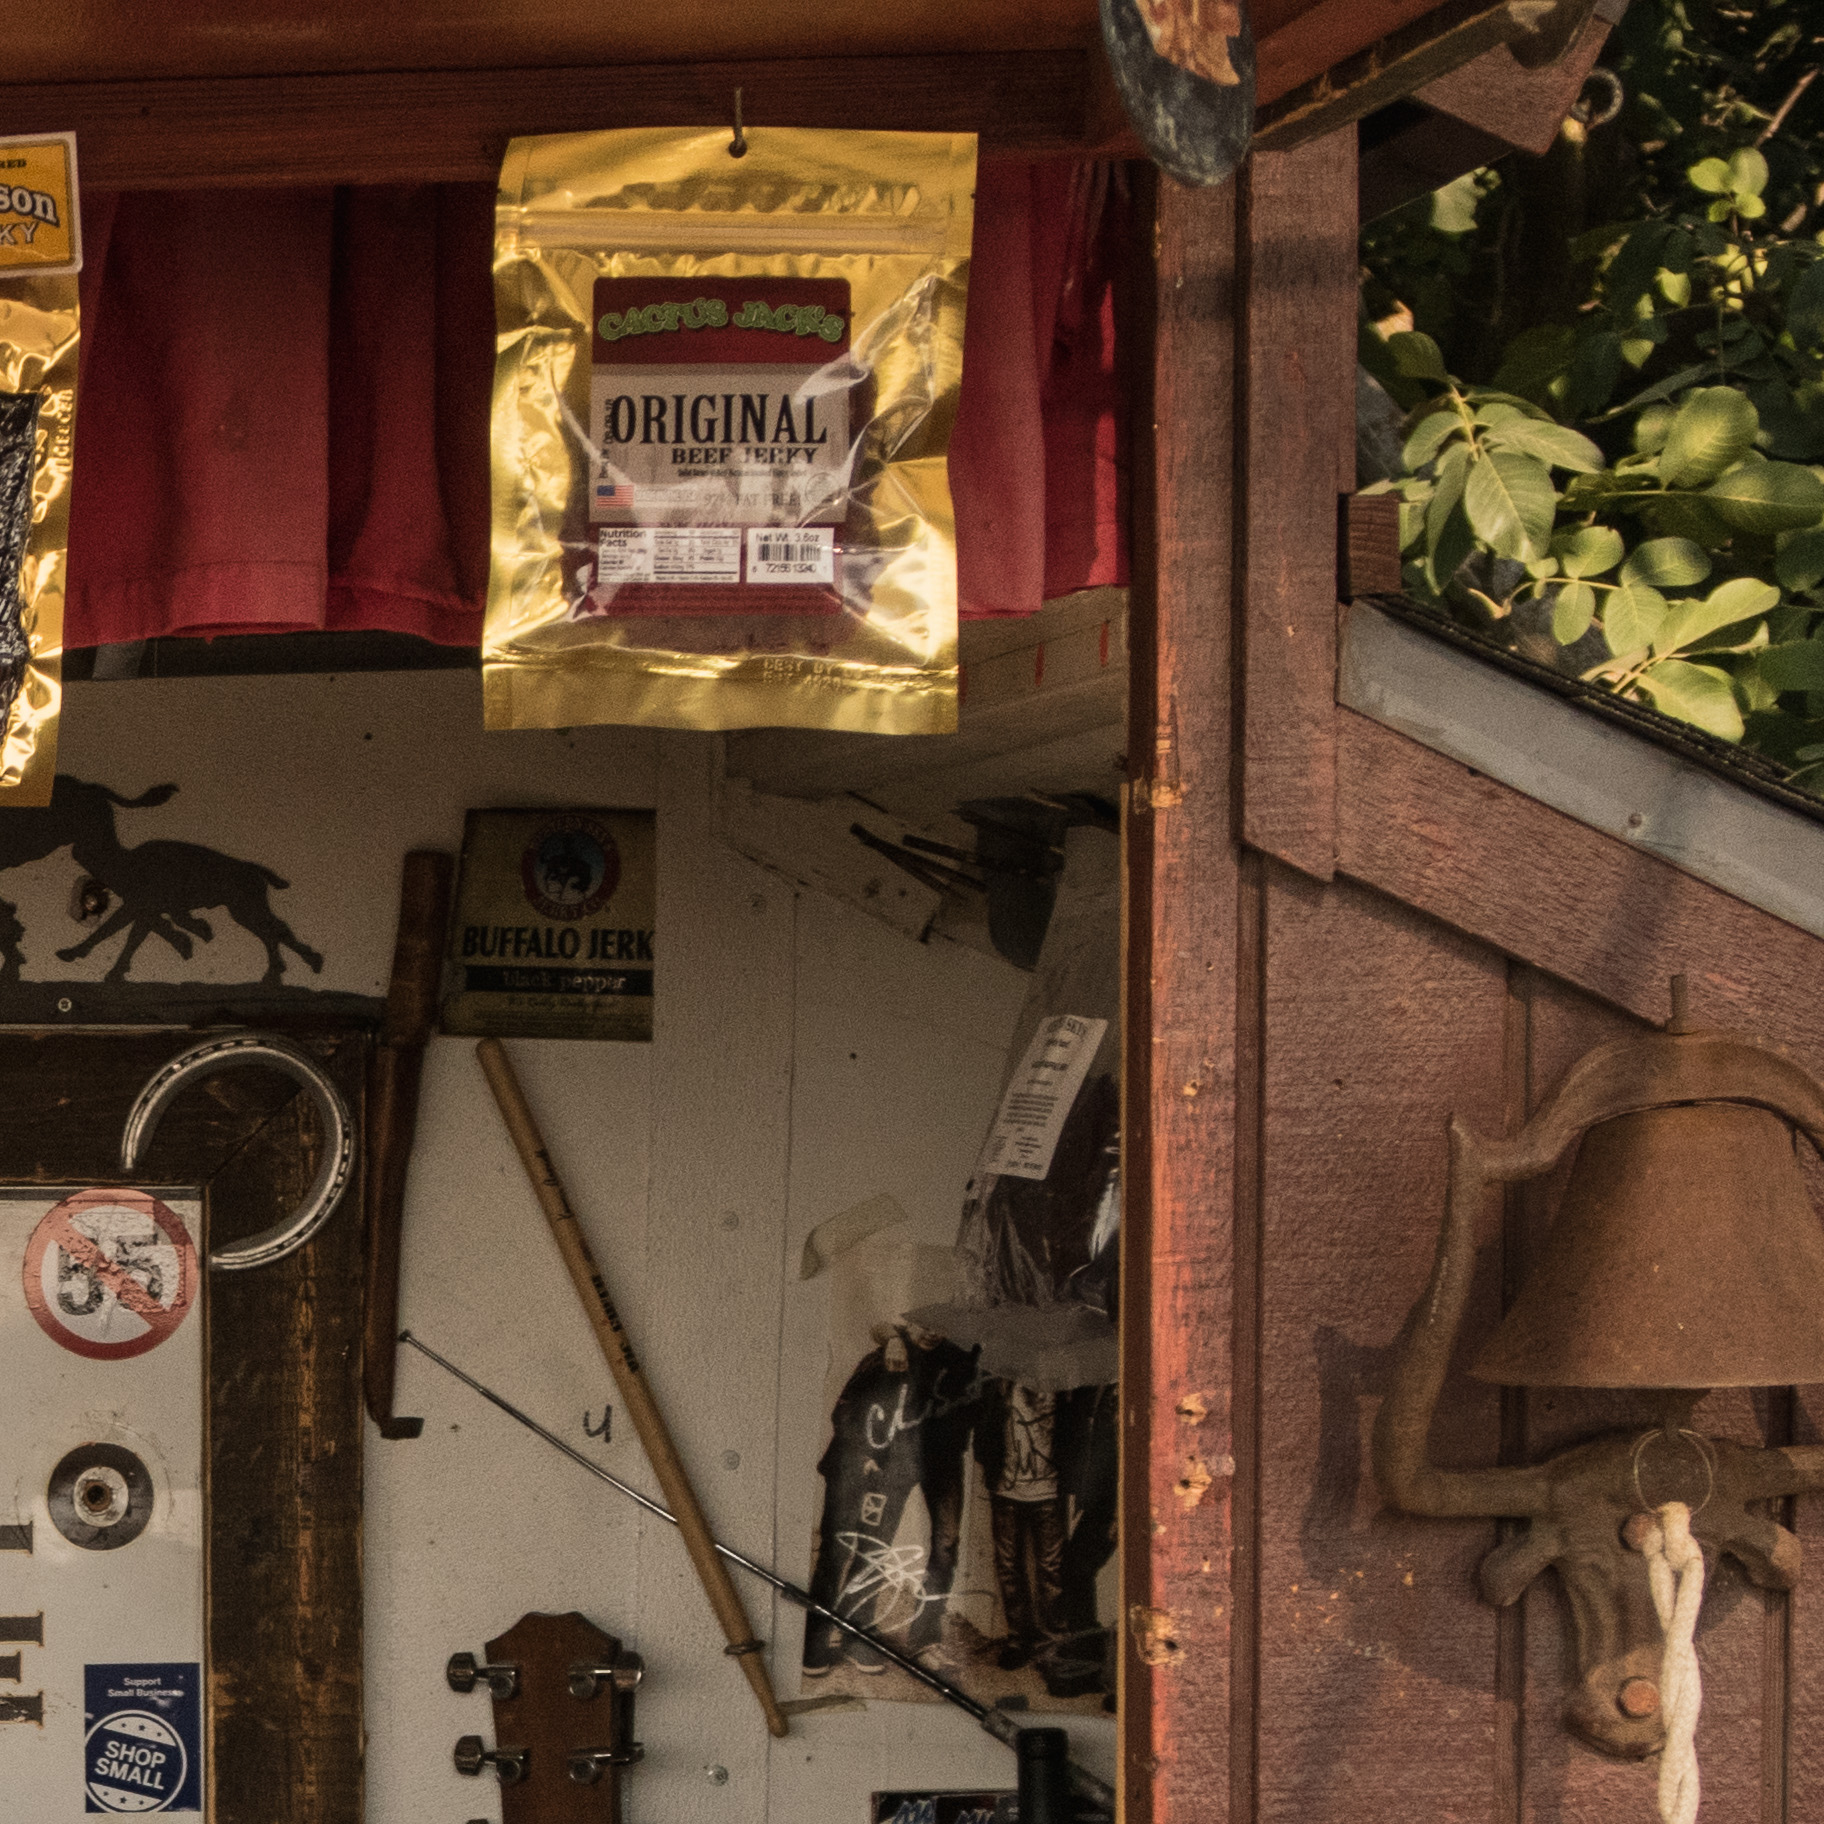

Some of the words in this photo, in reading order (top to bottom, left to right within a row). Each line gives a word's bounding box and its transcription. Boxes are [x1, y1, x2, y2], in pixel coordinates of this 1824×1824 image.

[598, 297, 728, 341] CACTUS
[610, 393, 827, 444] ORIGINAL
[671, 447, 733, 465] BEEF
[600, 529, 646, 539] Nutrition
[600, 539, 628, 547] Facts
[756, 532, 772, 542] Net
[462, 925, 582, 960] BUFFALO
[587, 928, 655, 962] JERK
[559, 973, 627, 992] pepper
[123, 1676, 162, 1688] Support
[107, 1688, 136, 1698] Small
[104, 1740, 167, 1769] SHOP
[94, 1757, 166, 1790] SMALL
